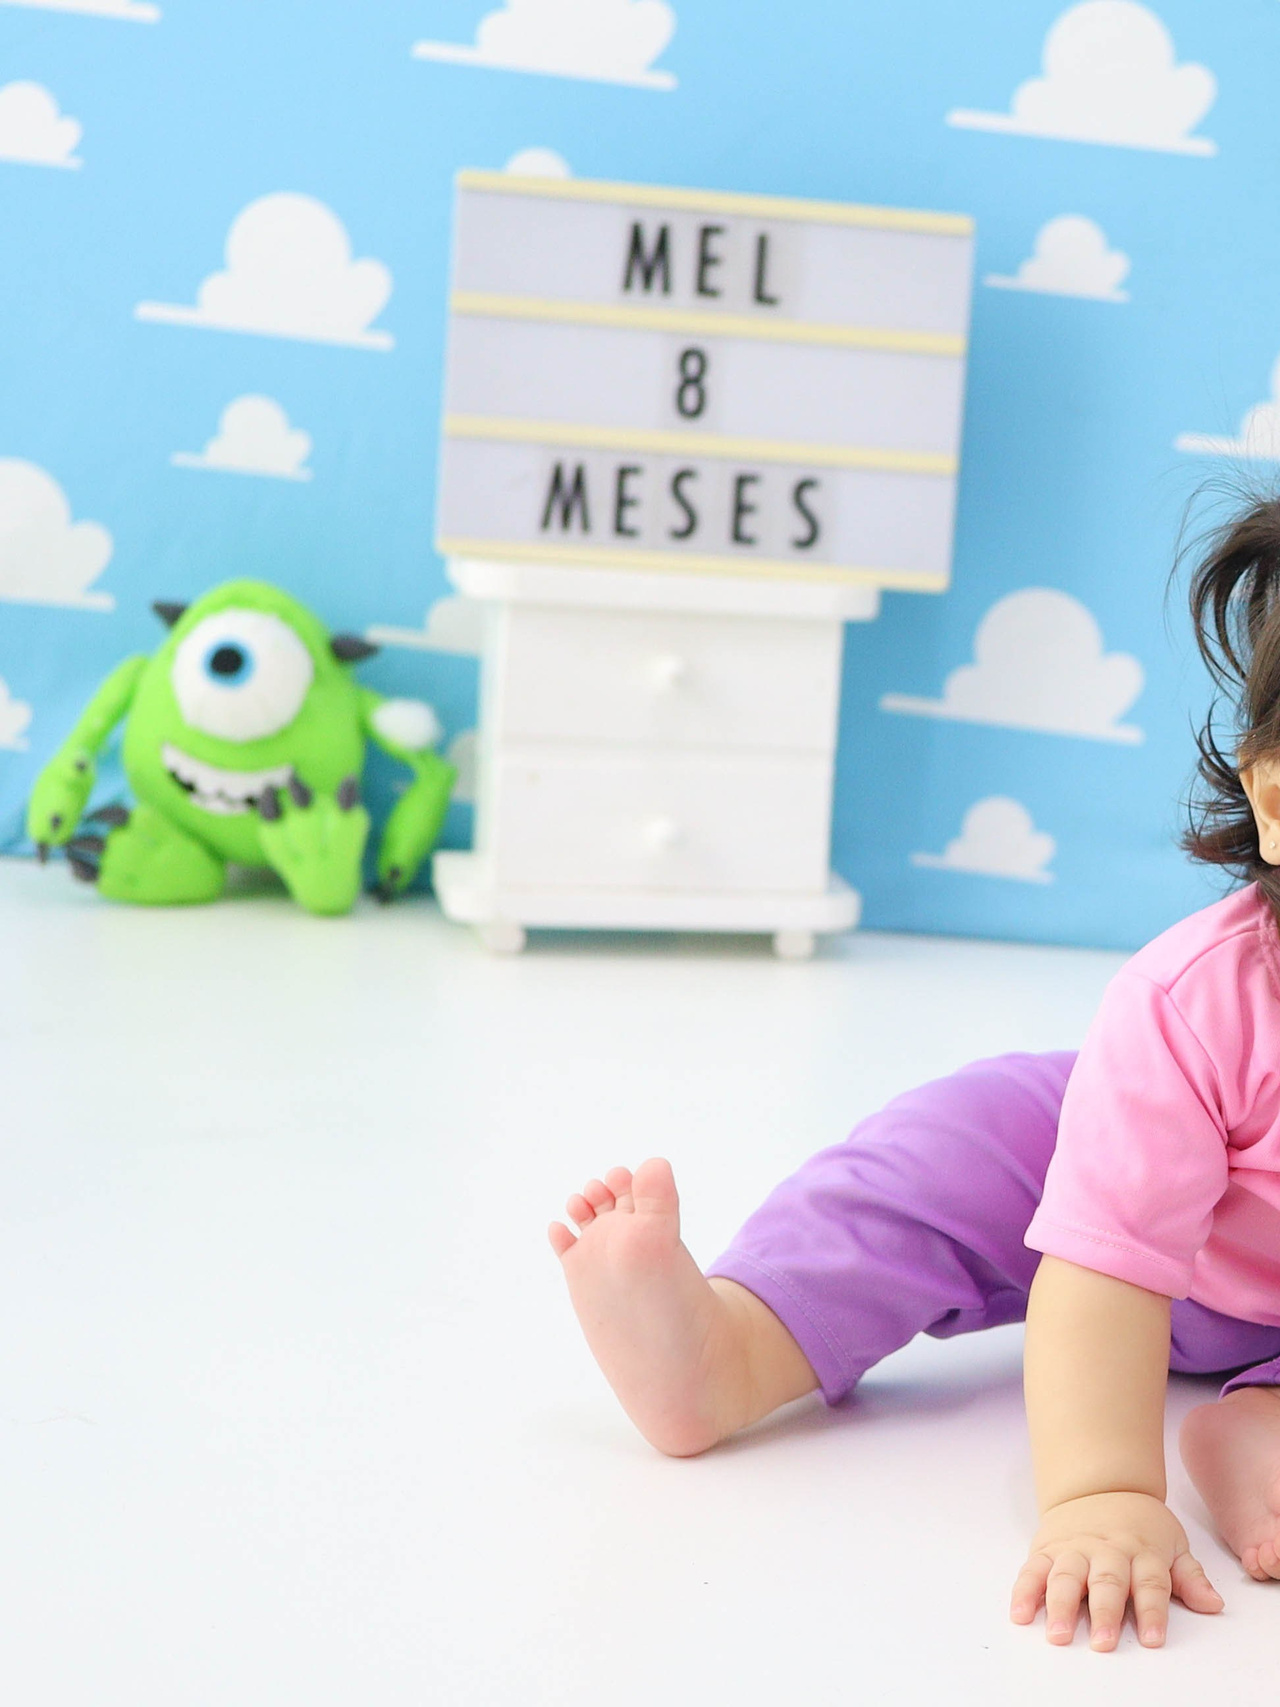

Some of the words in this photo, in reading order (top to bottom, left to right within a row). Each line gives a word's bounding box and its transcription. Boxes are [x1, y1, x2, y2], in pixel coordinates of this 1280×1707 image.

[622, 220, 780, 307] MEL
[674, 346, 710, 421] 8
[540, 461, 821, 551] MESES
